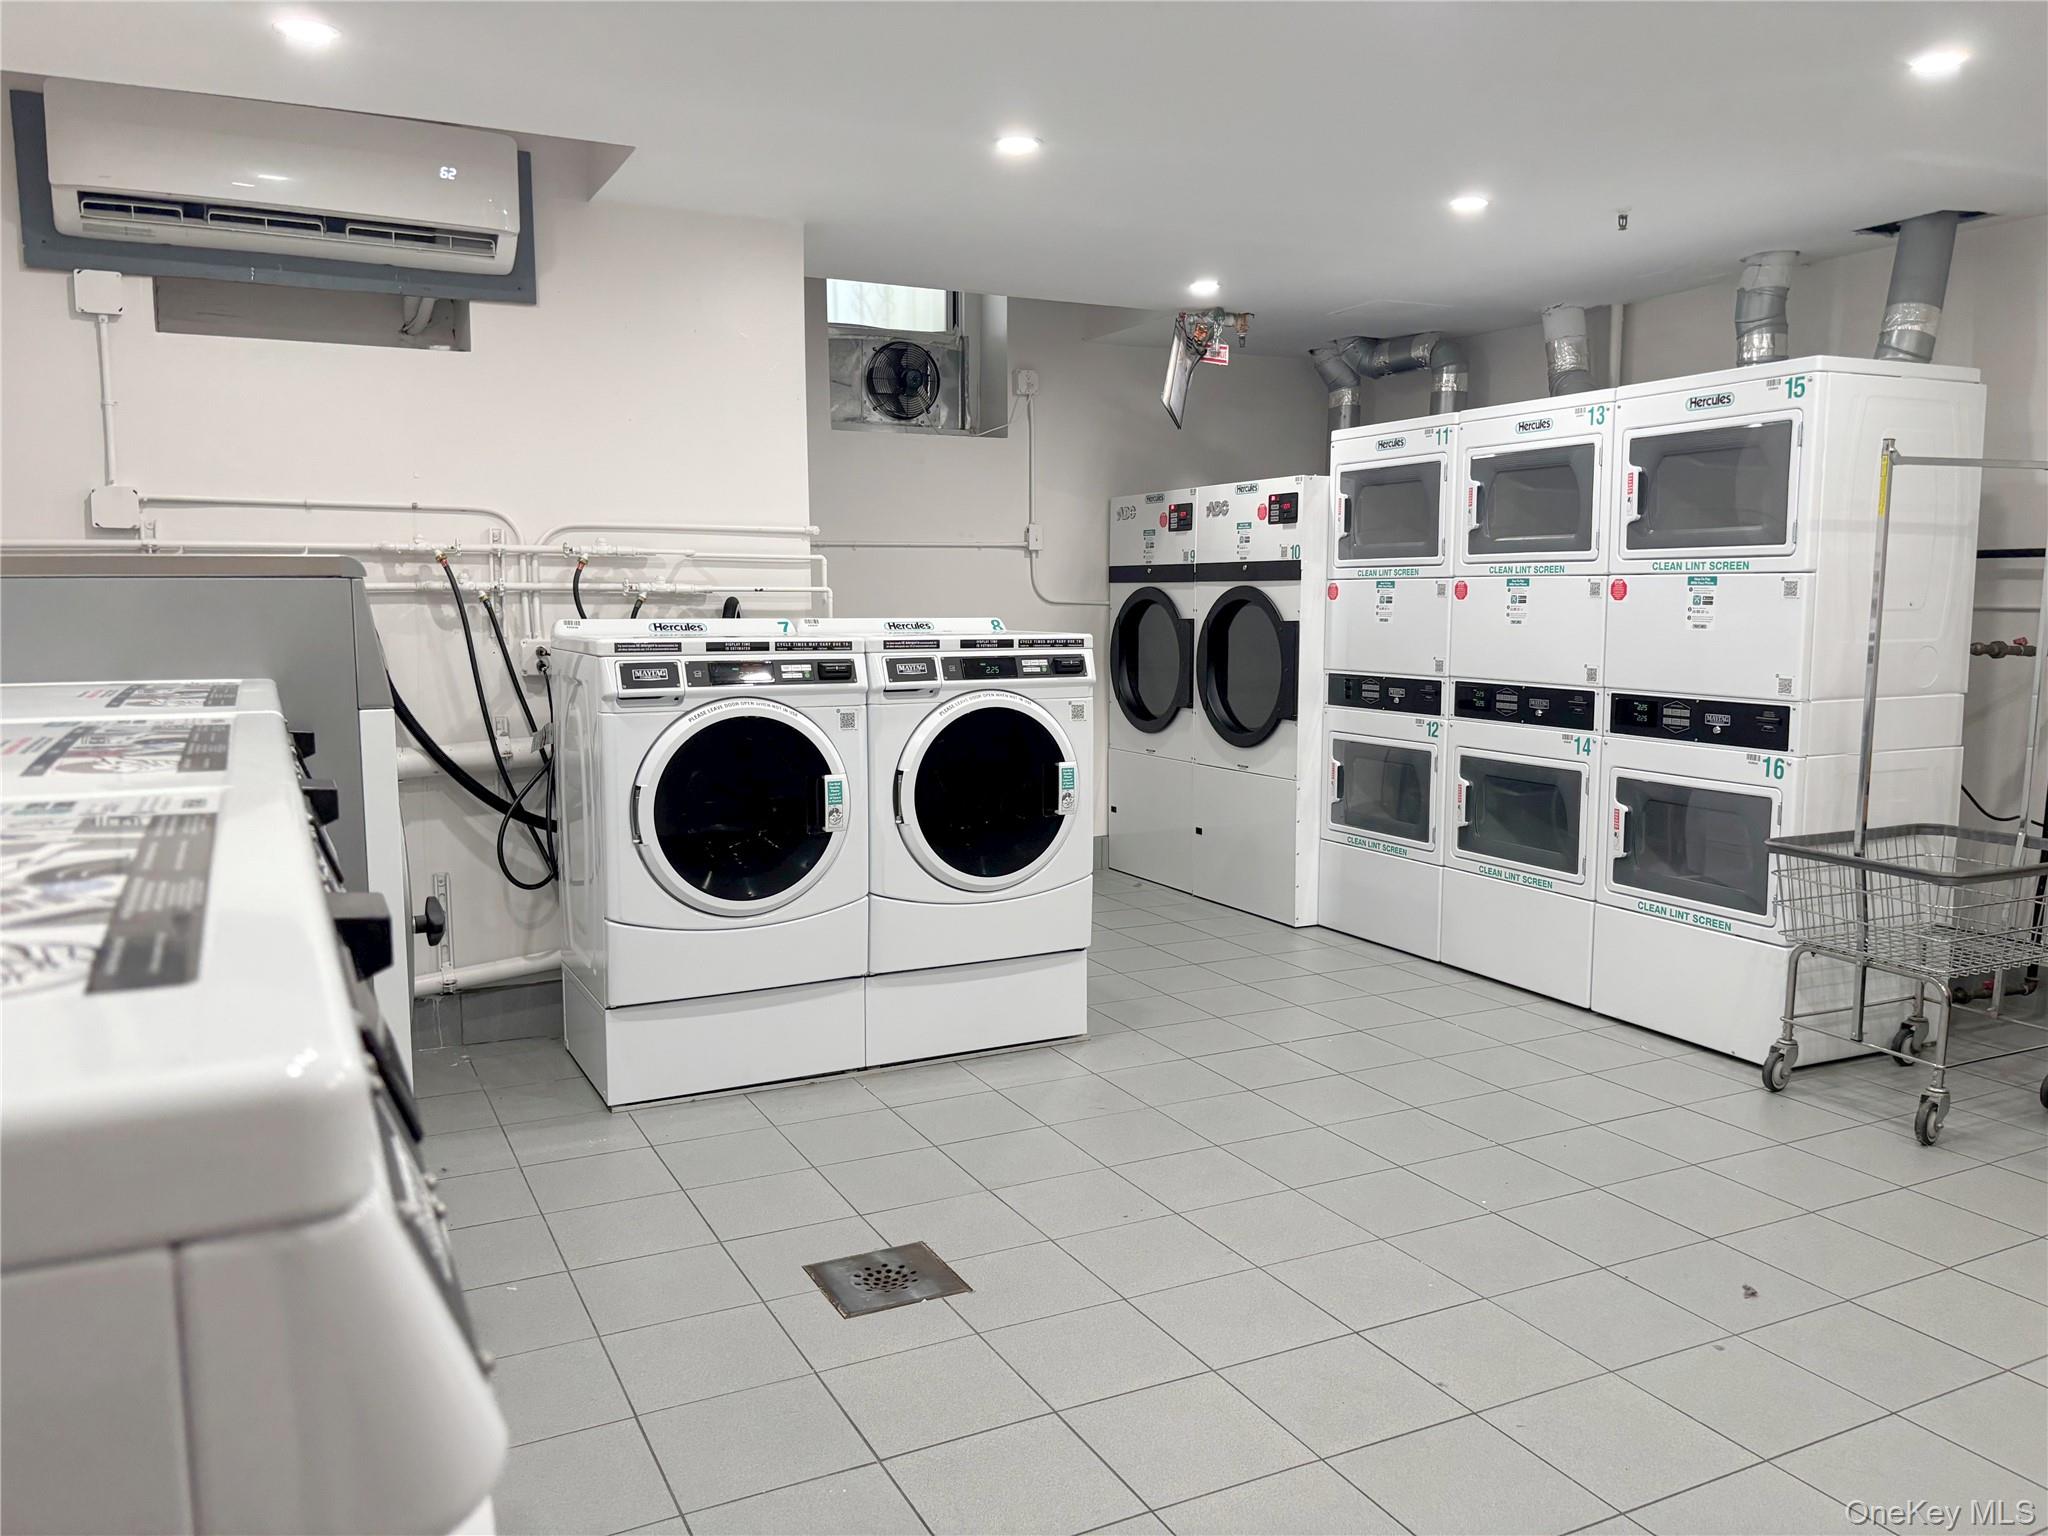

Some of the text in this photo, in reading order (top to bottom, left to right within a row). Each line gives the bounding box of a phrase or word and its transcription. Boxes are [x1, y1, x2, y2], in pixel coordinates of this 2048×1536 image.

[440, 166, 457, 180] 62
[1785, 376, 1805, 399] 15
[1689, 394, 1731, 409] Hercules
[1587, 405, 1605, 426] 13
[1518, 419, 1550, 432] Hercules
[1378, 438, 1404, 449] Hercules
[1435, 427, 1449, 446] 11
[1236, 484, 1257, 493] Hercules
[1190, 550, 1196, 562] 9
[1290, 544, 1300, 560] 10
[1357, 568, 1420, 577] CLEAN LINT SCREEN
[1489, 565, 1565, 574] CLEAN LINT SCREEN
[1652, 561, 1750, 571] CLEAN LINT SCREEN
[653, 622, 704, 632] Hercules
[777, 622, 789, 633] 7
[888, 621, 931, 630] Hercules
[688, 712, 706, 722] PLEASE
[707, 705, 723, 714] LEAVE
[939, 703, 955, 716] PLEASE
[1706, 714, 1730, 723] MAYTAG
[1426, 722, 1439, 738] 12
[1574, 737, 1591, 756] 14
[1762, 756, 1784, 780] 16
[1347, 836, 1408, 856] CLEAN LINT SCREEN
[1478, 866, 1553, 889] CLEAN LINT SCREEN
[1638, 901, 1732, 932] CLEAN LINT SCREEN
